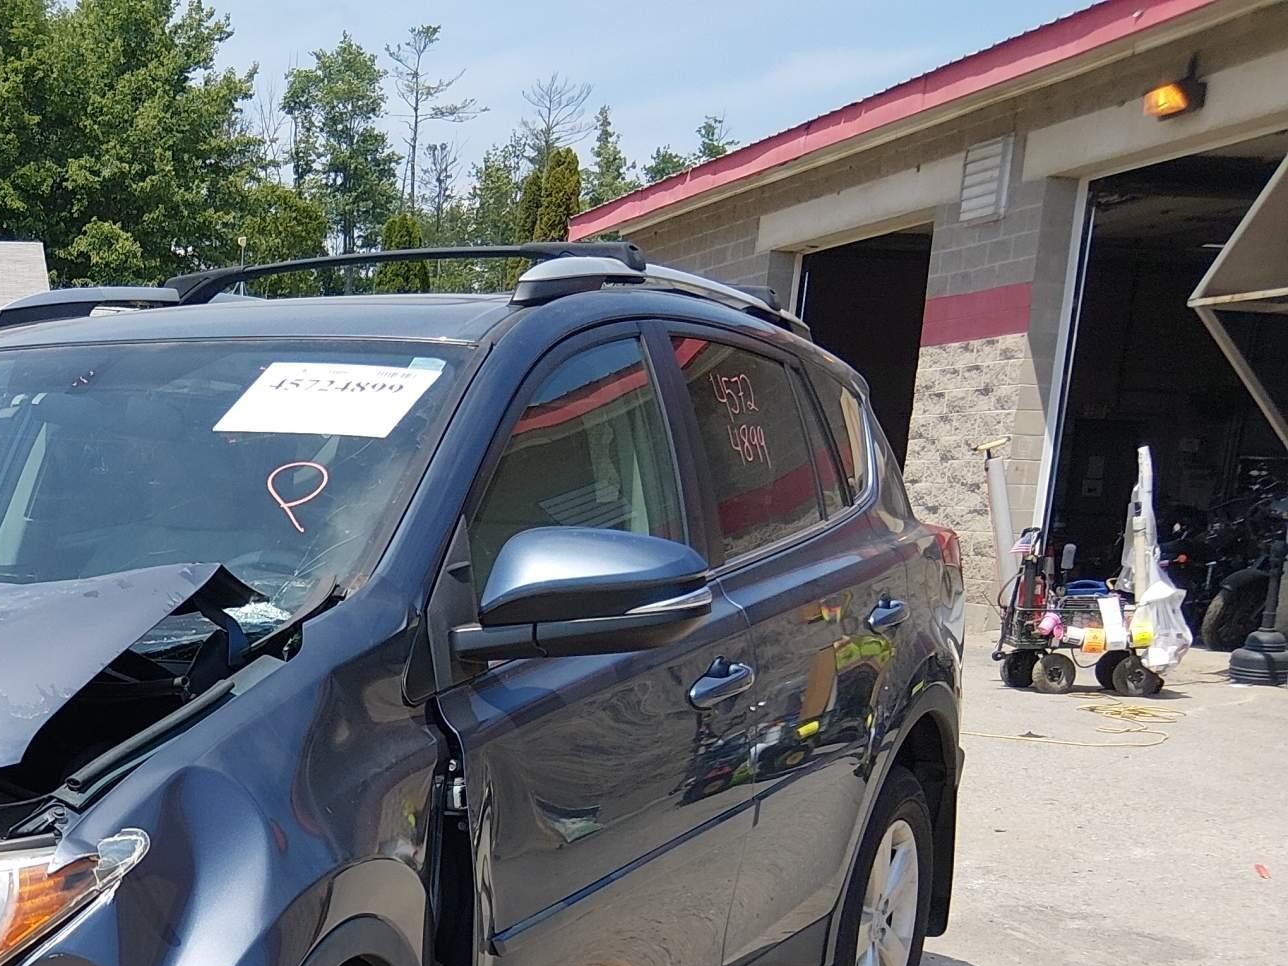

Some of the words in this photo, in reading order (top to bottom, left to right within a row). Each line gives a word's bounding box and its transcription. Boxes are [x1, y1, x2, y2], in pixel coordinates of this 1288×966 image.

[269, 377, 405, 393] 45724899
[710, 373, 759, 423] 4572
[727, 424, 772, 469] 4899
